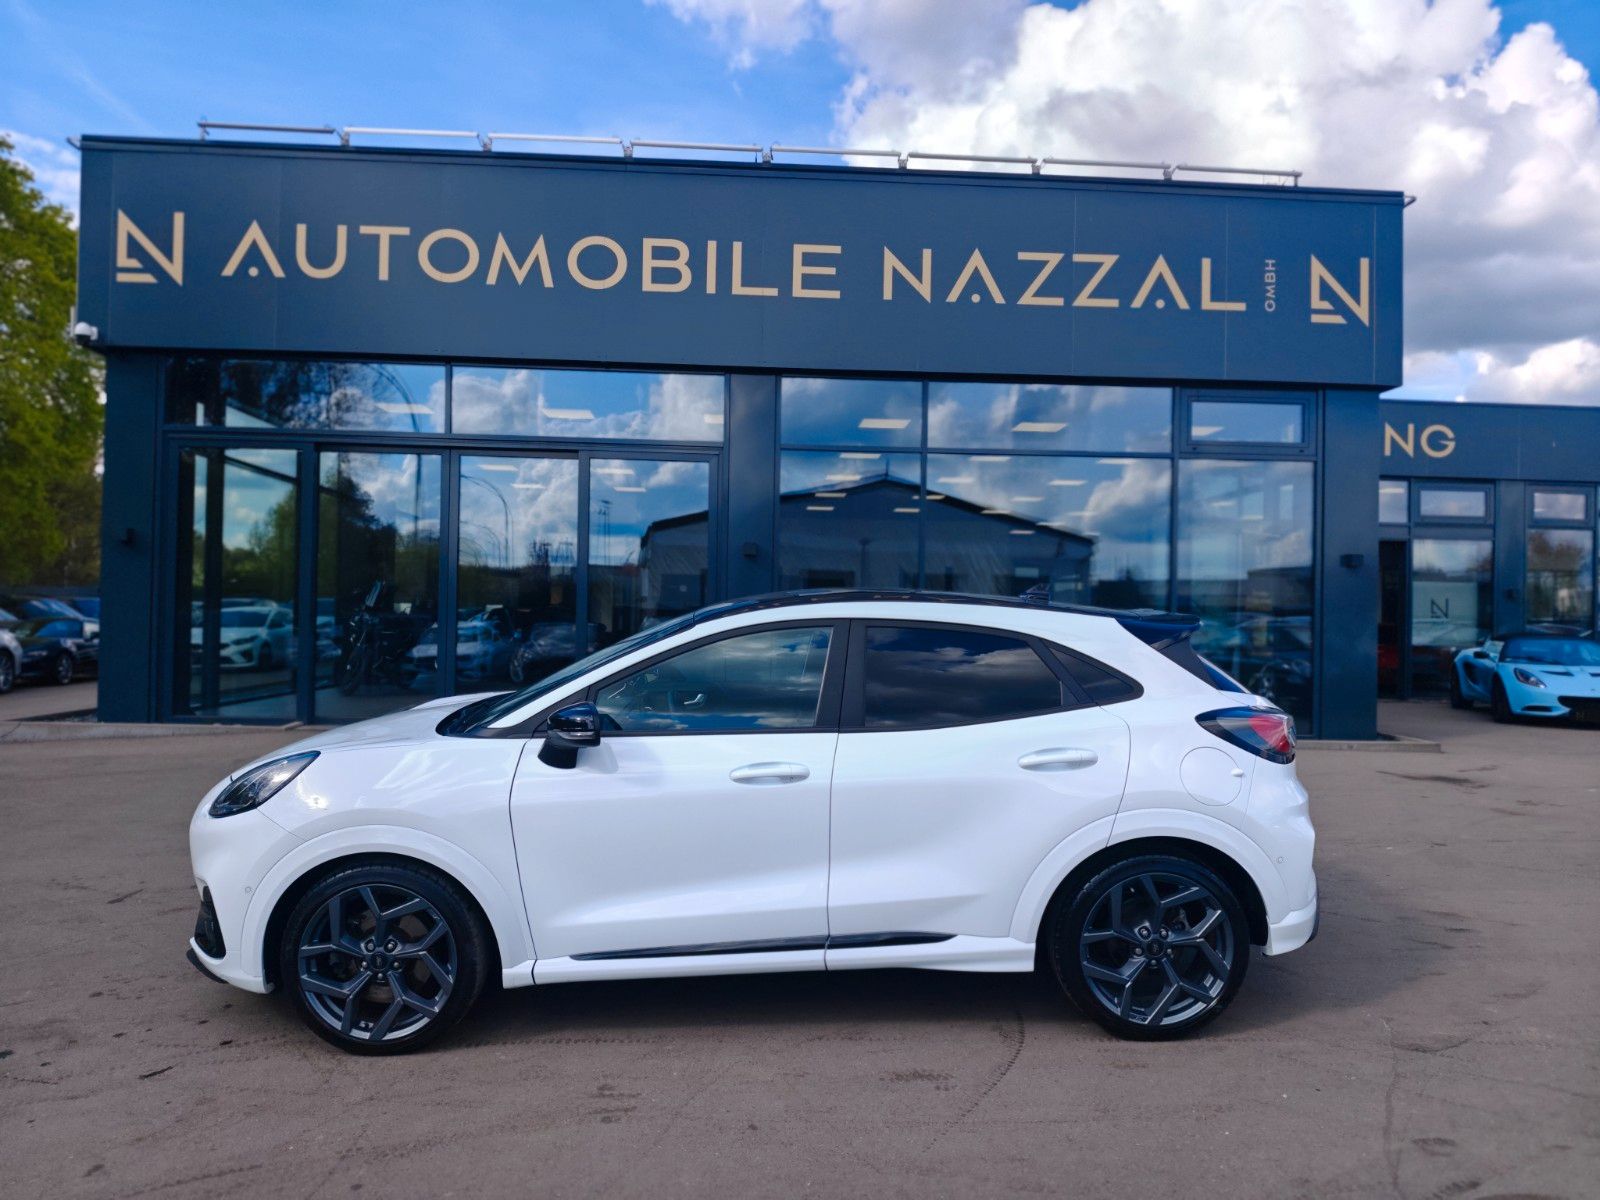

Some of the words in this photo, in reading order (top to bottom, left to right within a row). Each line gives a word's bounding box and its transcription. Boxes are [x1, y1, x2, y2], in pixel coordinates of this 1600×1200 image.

[221, 219, 842, 299] AUTOMOBILE
[881, 247, 1246, 312] NAZZAL
[1264, 259, 1276, 312] GMBH
